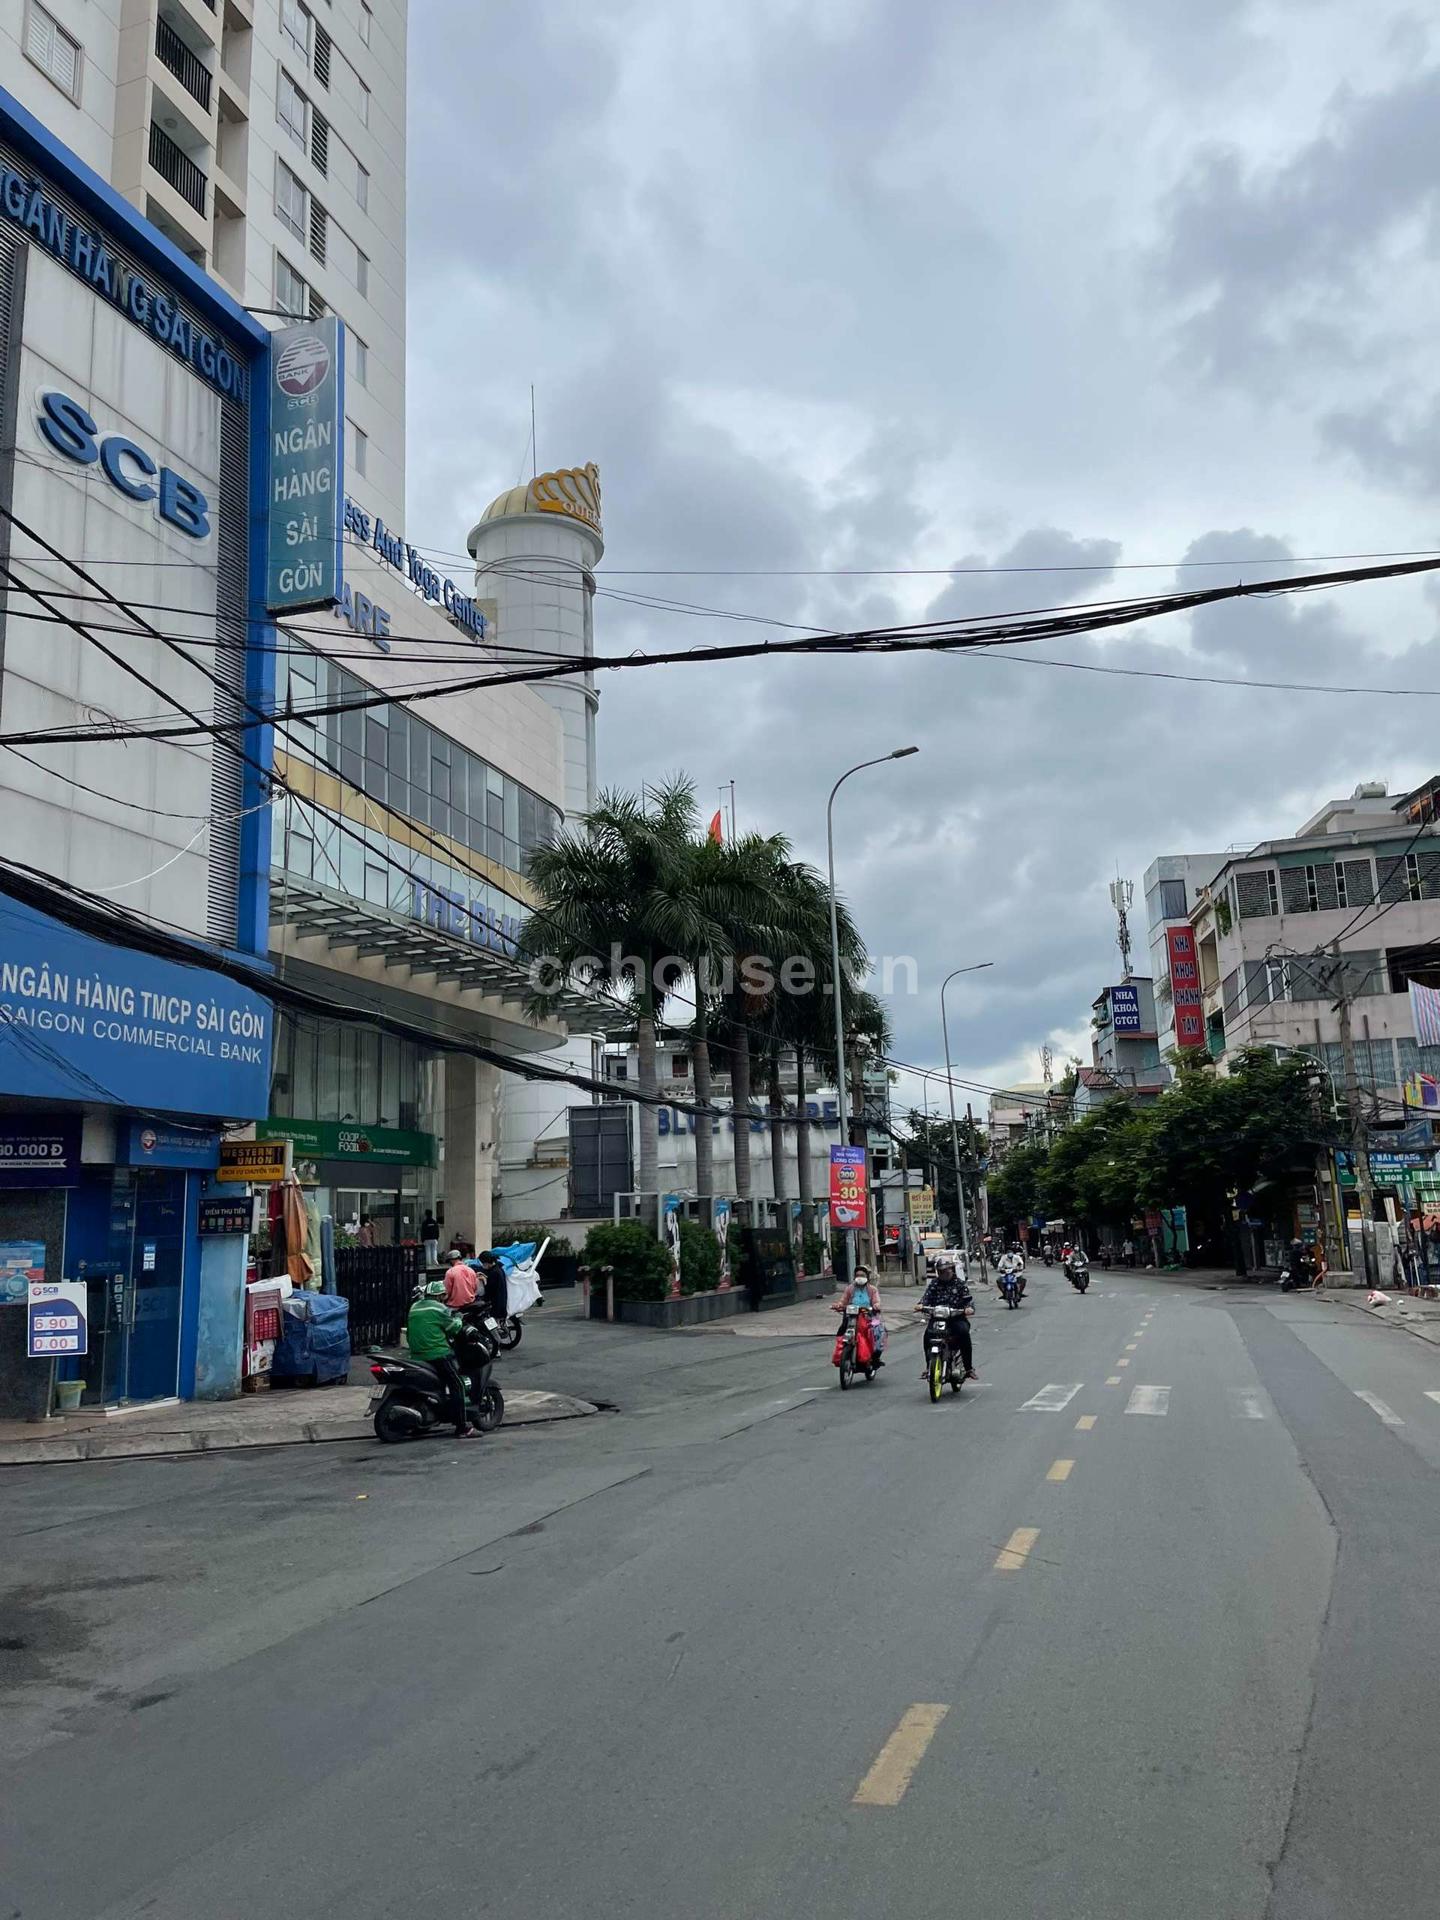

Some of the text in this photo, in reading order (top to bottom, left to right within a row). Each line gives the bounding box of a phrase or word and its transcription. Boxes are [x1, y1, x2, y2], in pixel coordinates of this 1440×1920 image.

[0, 163, 70, 258] GÂN
[278, 368, 310, 382] BANK
[274, 417, 333, 457] NGÂN
[38, 390, 211, 540] SCB
[273, 466, 332, 503] HÀNG
[285, 511, 319, 546] SÀI
[278, 558, 323, 594] GÒN
[373, 517, 404, 571] And
[406, 543, 441, 601] Yoga
[443, 578, 489, 640] Center
[407, 873, 529, 960] THE BLU
[1174, 934, 1190, 952] NHA
[1174, 961, 1195, 980] KHOA
[1, 961, 265, 1040] NGÂN HÀNG TMCP SÀI GÒN
[1113, 1003, 1139, 1013] KHOA
[1115, 990, 1135, 1000] NHA
[0, 1003, 263, 1065] SAIGON COMMERCIAL BANK
[1114, 1015, 1139, 1025] GTGT
[221, 1147, 274, 1157] WESTERN
[236, 1156, 274, 1166] UNION
[42, 1286, 58, 1294] SCB
